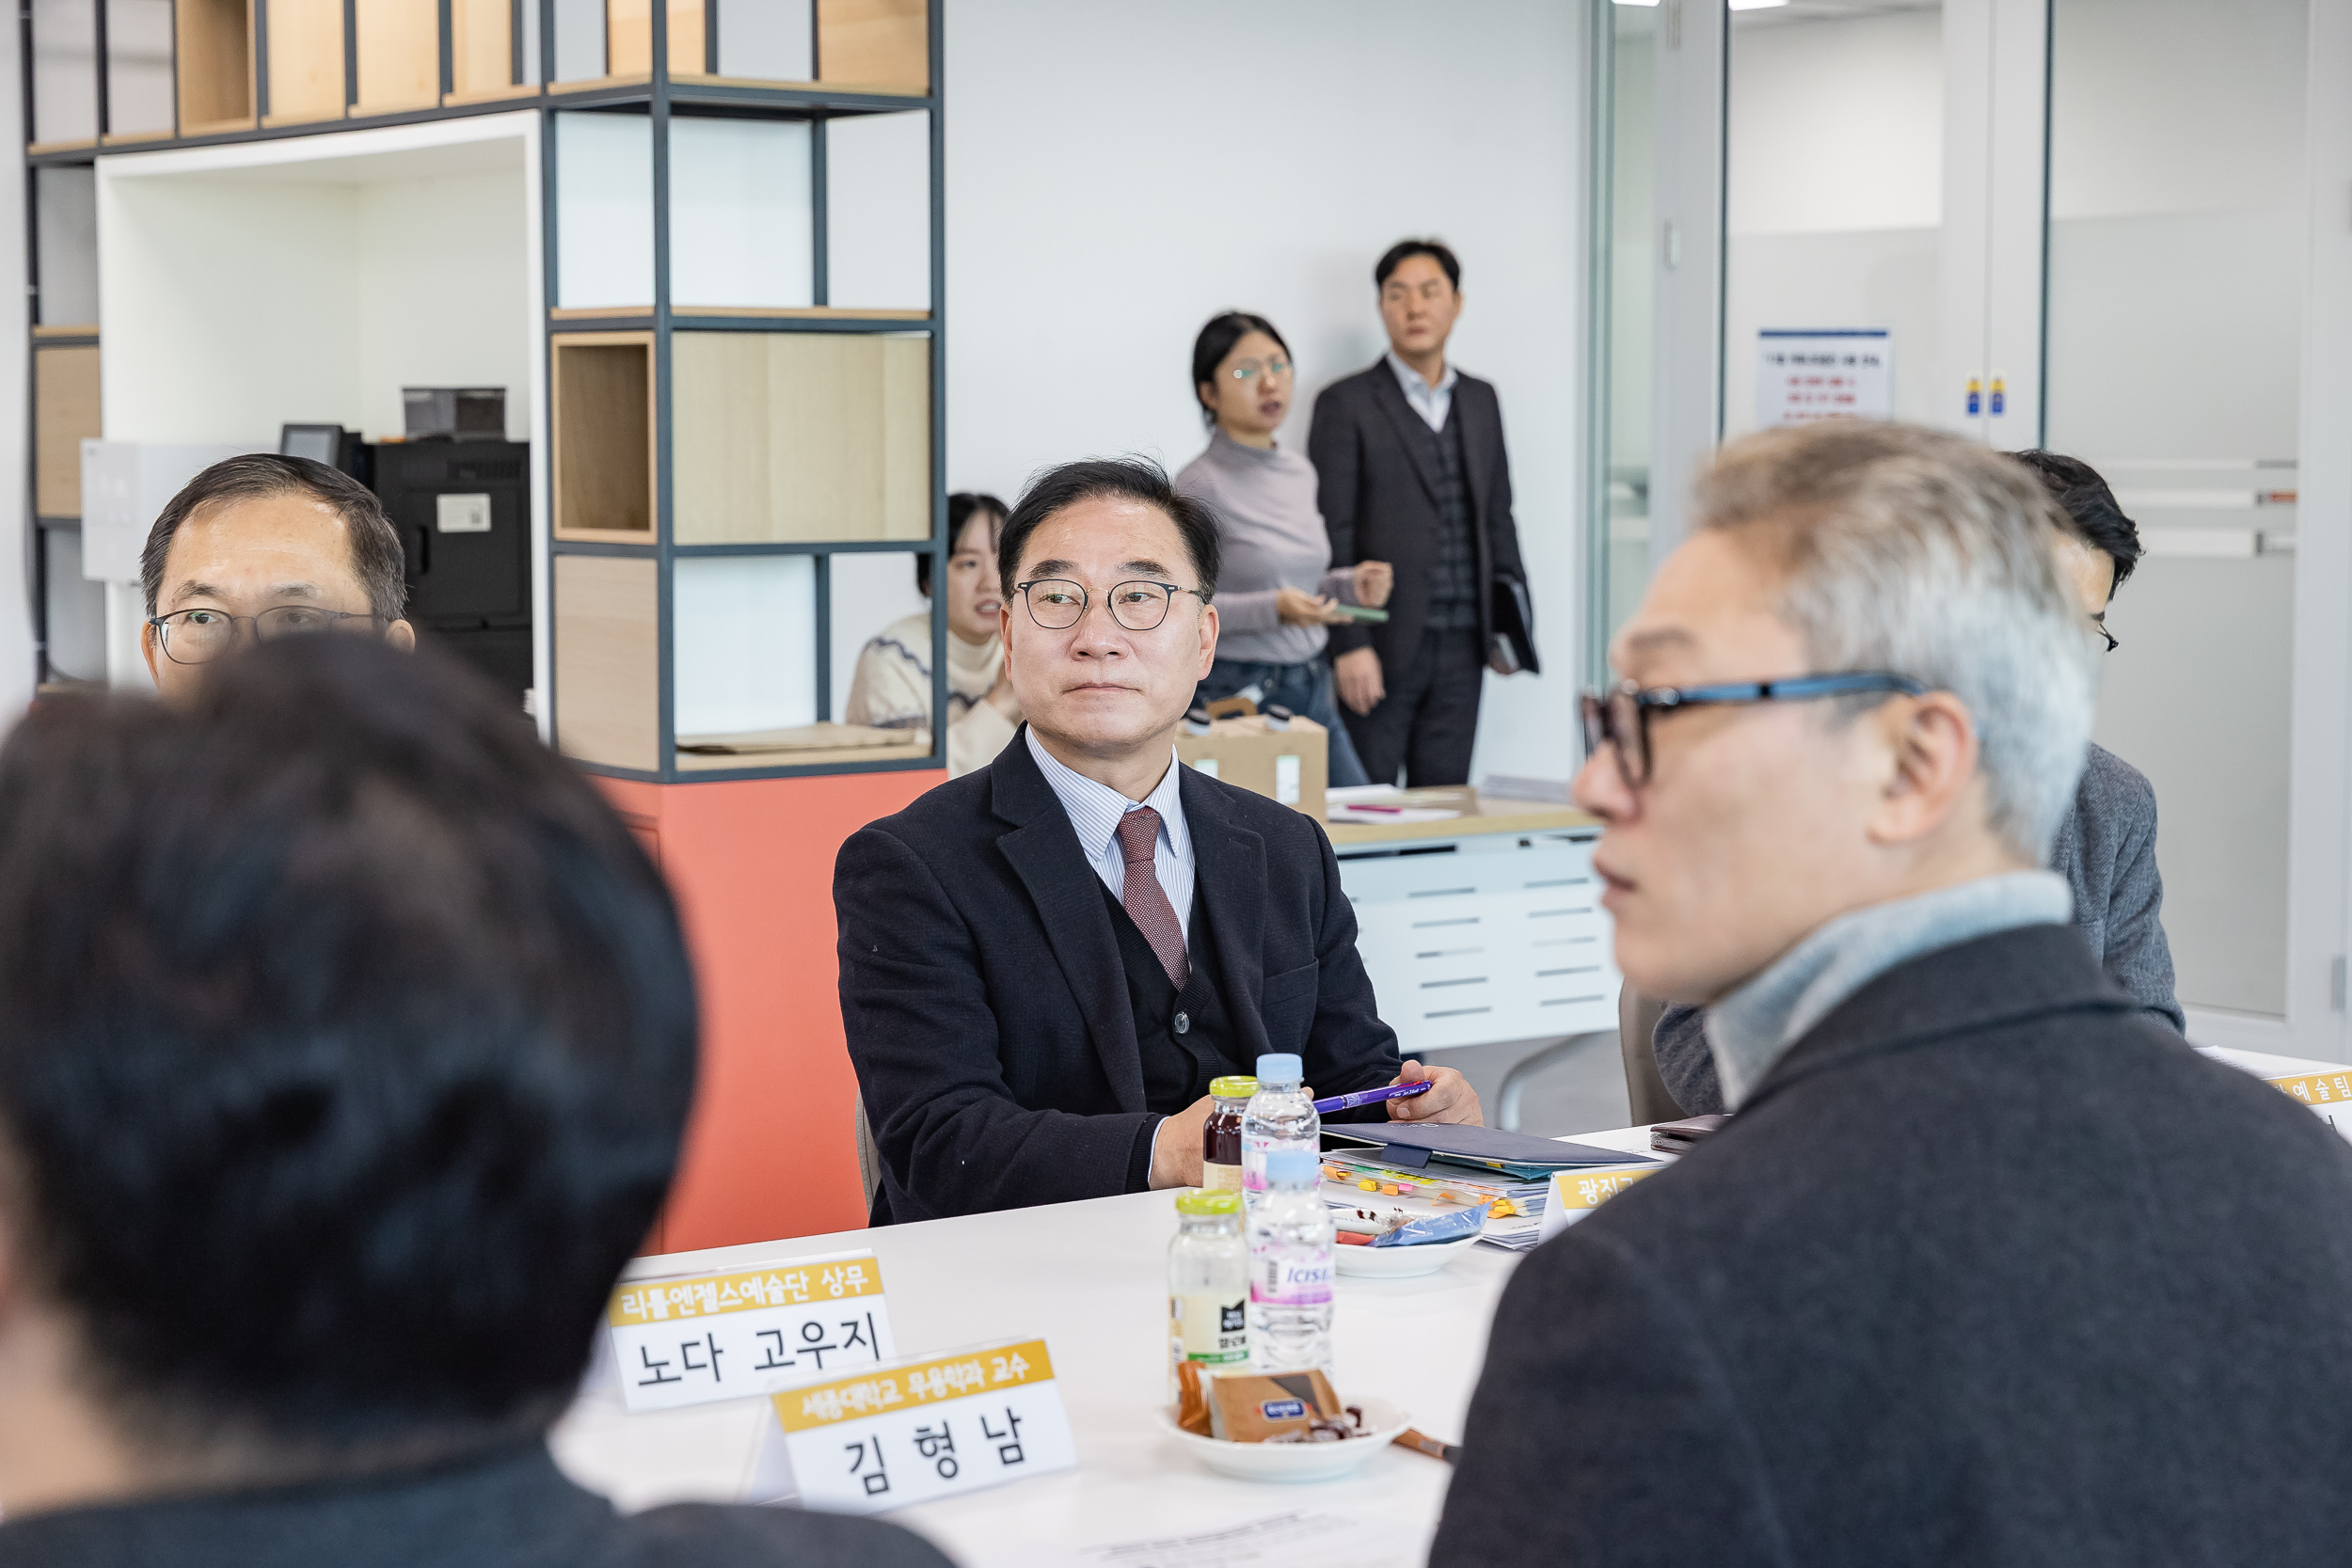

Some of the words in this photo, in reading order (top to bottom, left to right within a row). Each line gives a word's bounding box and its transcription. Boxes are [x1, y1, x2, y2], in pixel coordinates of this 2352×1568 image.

[621, 1271, 809, 1320] 리틀엔젤스예술단
[820, 1265, 868, 1296] 상무
[638, 1332, 723, 1386] 노다
[755, 1311, 881, 1370] 고우지
[991, 1352, 1031, 1383] 교수
